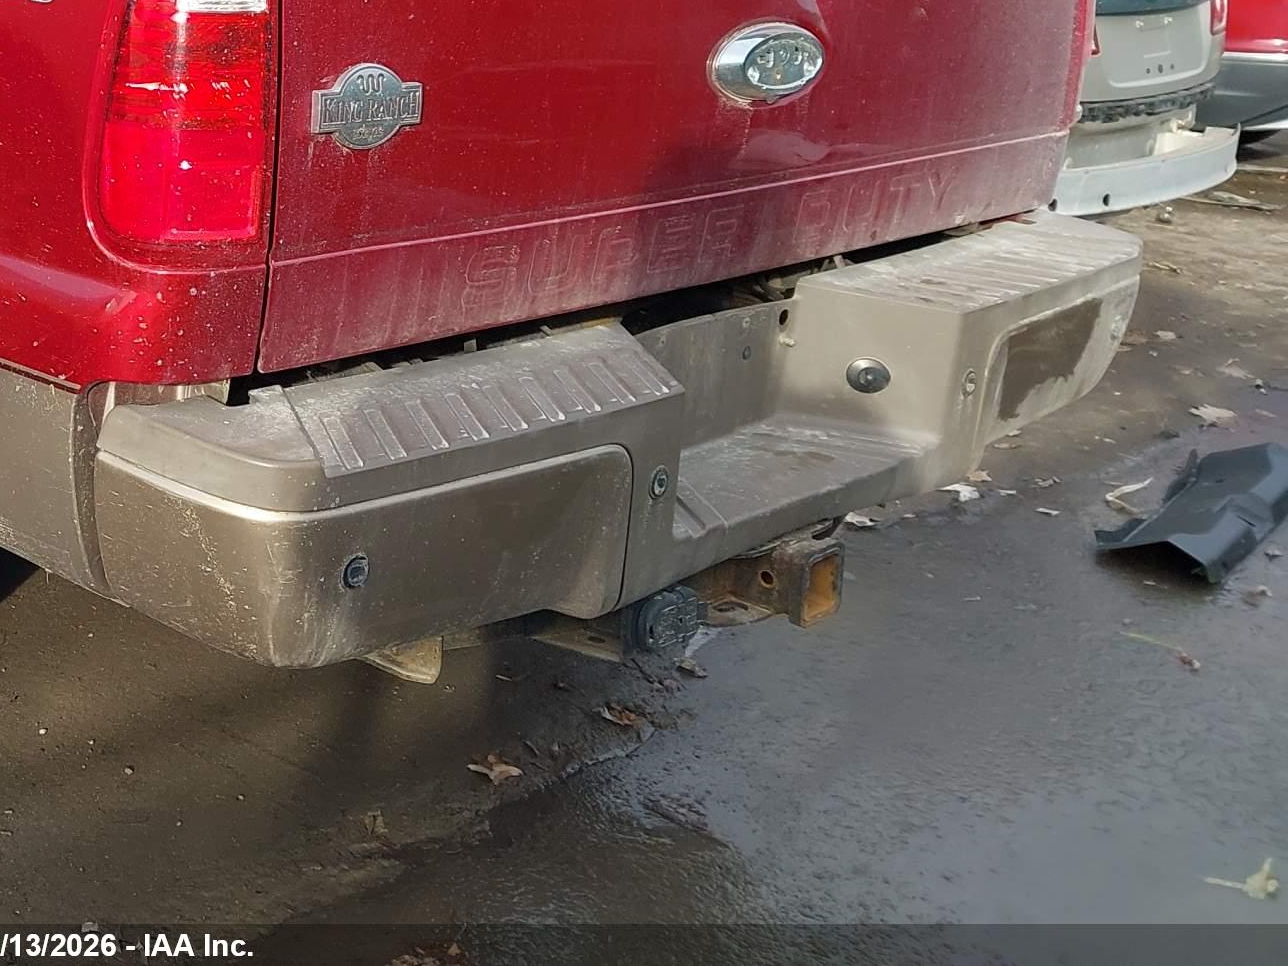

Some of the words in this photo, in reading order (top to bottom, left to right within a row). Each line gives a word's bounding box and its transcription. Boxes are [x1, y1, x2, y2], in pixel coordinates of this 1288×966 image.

[323, 96, 365, 125] KING
[367, 91, 420, 122] RANCH
[463, 205, 747, 302] SUPER
[792, 159, 962, 246] DUTY
